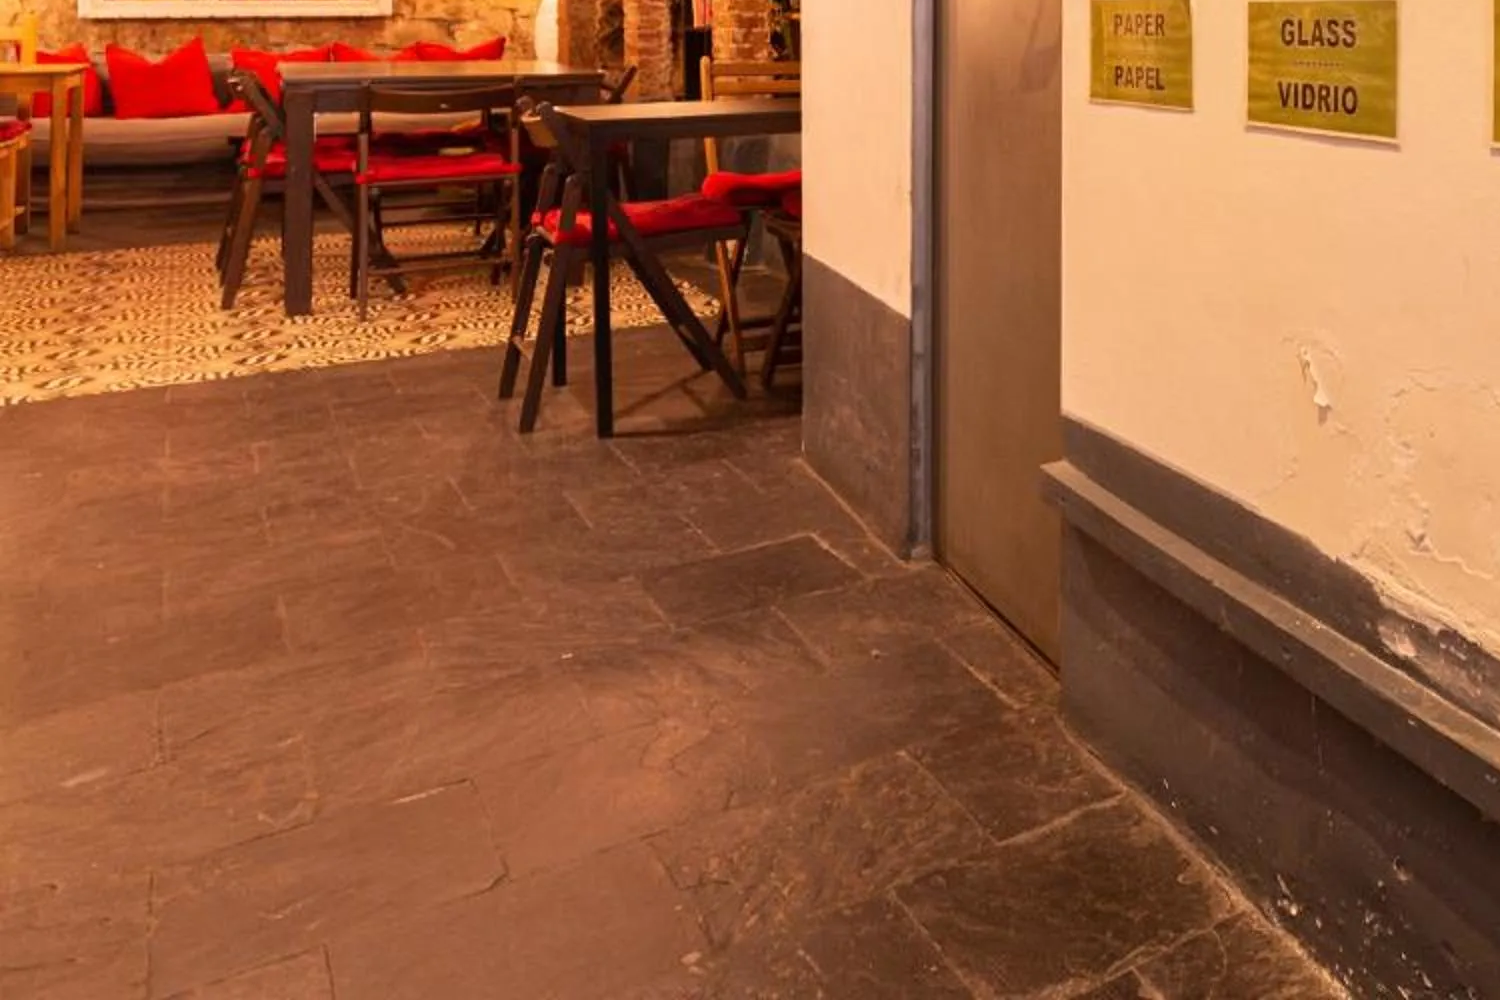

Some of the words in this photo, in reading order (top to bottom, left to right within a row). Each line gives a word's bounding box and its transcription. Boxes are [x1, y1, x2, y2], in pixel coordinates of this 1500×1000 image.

[1113, 13, 1165, 37] PAPER
[1281, 18, 1356, 48] GLASS
[1114, 64, 1165, 91] PAPEL
[1277, 81, 1358, 115] VIDRIO
